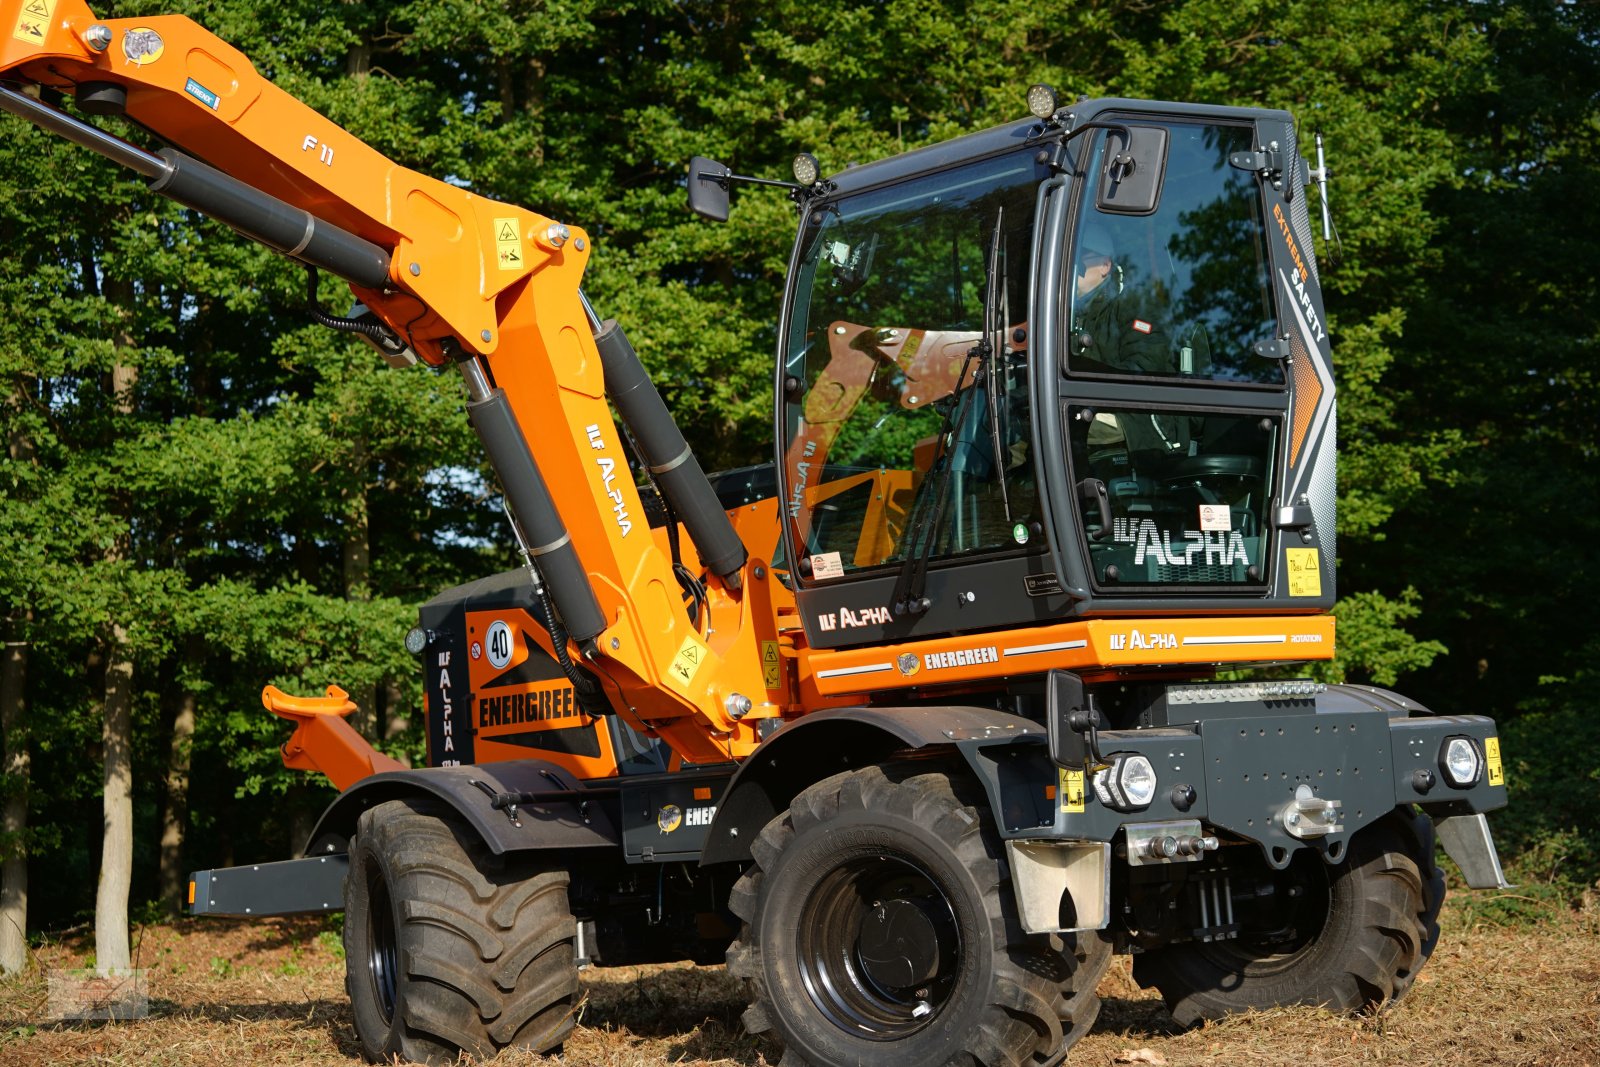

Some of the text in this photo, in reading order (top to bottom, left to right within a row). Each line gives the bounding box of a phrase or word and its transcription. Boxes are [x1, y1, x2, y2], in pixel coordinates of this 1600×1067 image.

[186, 83, 213, 103] STRENX
[303, 134, 334, 166] F 11
[1273, 203, 1308, 283] EXTREME
[1291, 267, 1325, 343] SAFETY
[586, 424, 632, 538] ILF ALPHA
[1114, 517, 1139, 542] ILF
[1134, 518, 1249, 565] ALPHA
[818, 606, 893, 631] ILF ALPHA
[491, 629, 509, 660] 40
[1110, 629, 1322, 650] ILF ALPHA ROTATION
[924, 646, 999, 670] ENERGREEN
[438, 651, 454, 751] ILF ALPHA
